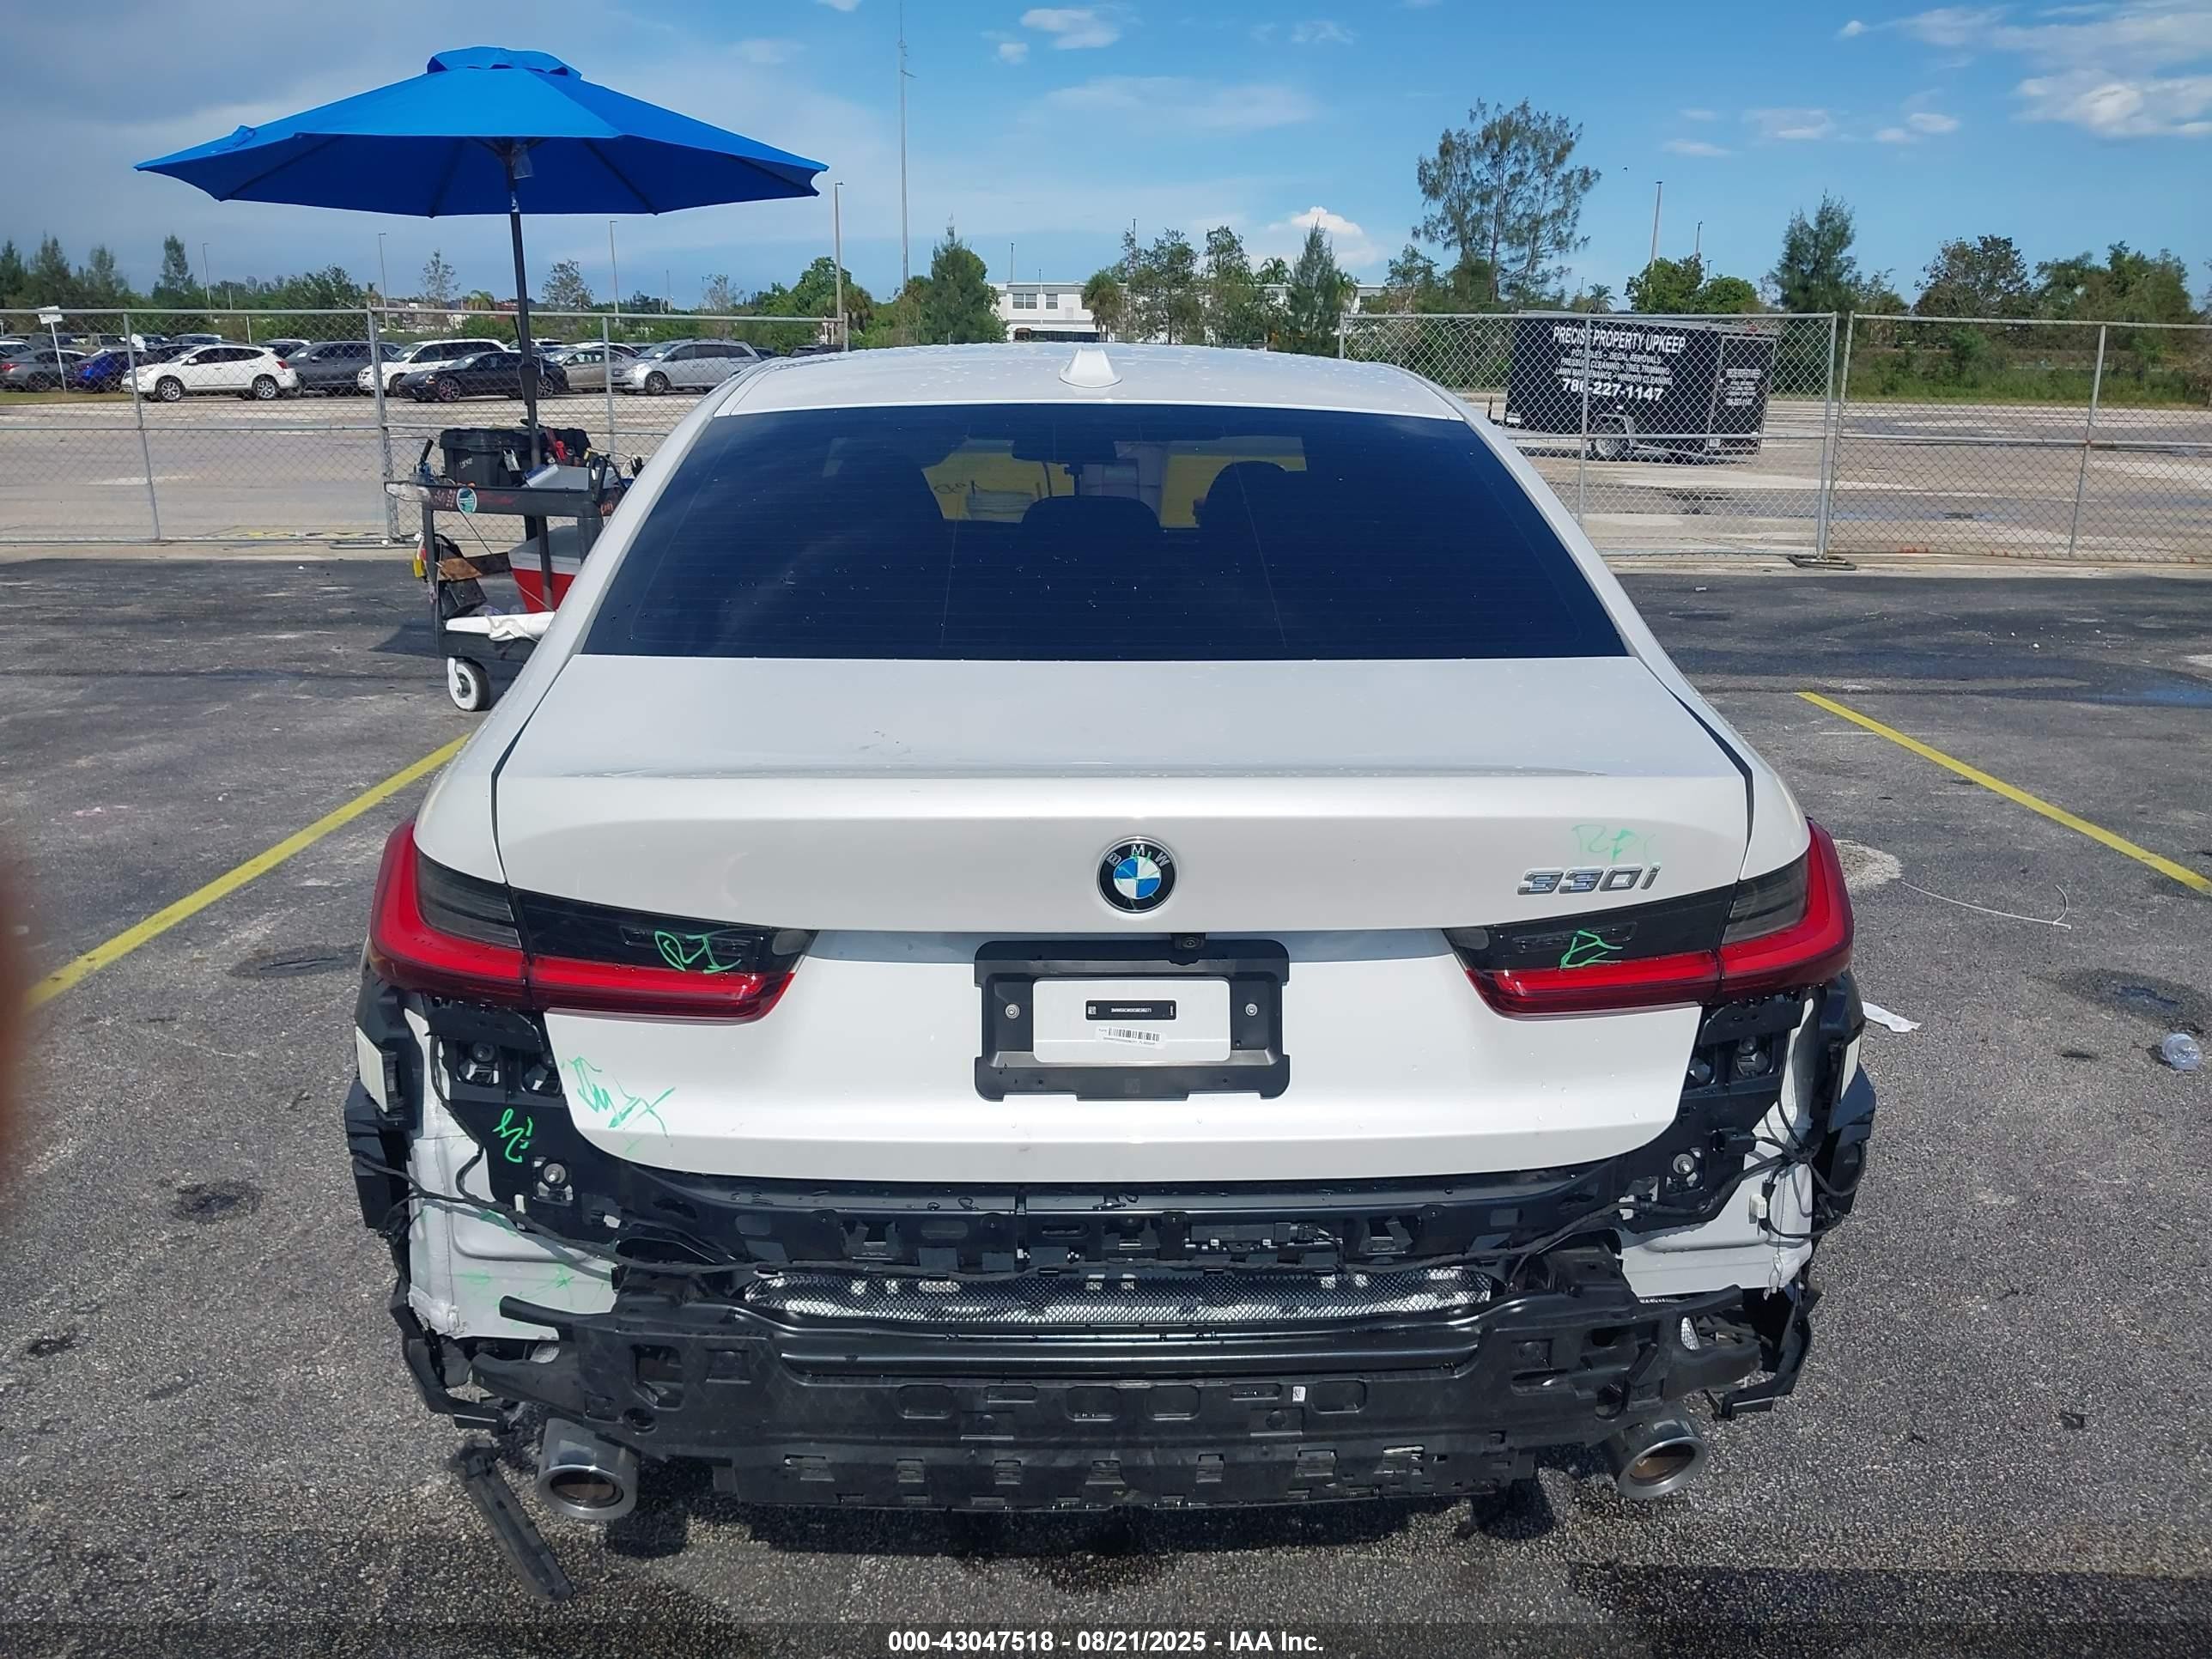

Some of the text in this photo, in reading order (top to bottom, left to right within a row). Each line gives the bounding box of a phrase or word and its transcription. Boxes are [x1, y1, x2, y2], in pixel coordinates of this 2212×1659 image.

[1593, 330, 1645, 349] PROPERTY
[1646, 334, 1686, 354] UPKEEP
[1590, 360, 1620, 371] CLEANING
[1626, 363, 1641, 373] TREE
[1642, 365, 1670, 375] TRIMMING
[1609, 352, 1628, 362] DECAL
[1630, 354, 1662, 364] REMOVALS
[1555, 367, 1571, 376] LAWN
[1617, 373, 1642, 383] WINDOW
[1643, 375, 1673, 386] CLEANING
[1106, 844, 1170, 867] BMW
[1516, 861, 1662, 896] 330i
